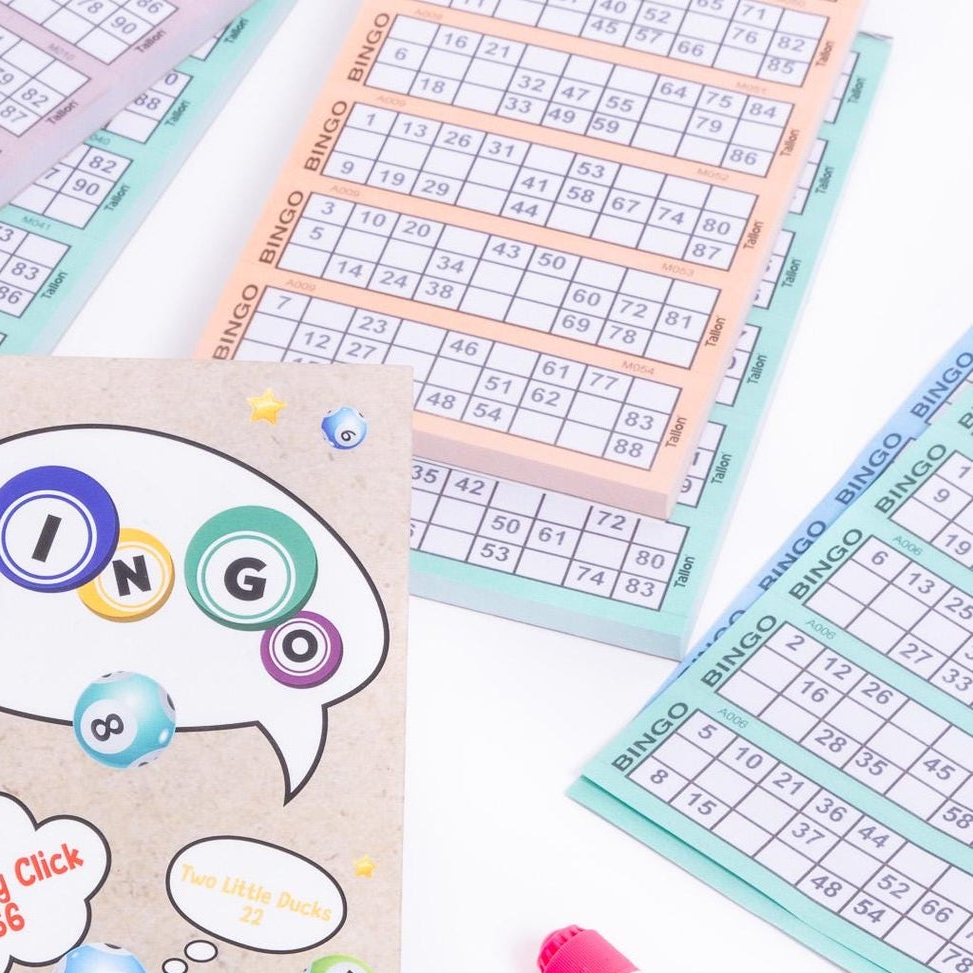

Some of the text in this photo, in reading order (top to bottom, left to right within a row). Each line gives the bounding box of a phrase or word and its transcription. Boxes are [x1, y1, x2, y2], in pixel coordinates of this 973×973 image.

[346, 12, 391, 83] BINGO
[88, 155, 117, 174] 82
[302, 100, 349, 173] BINGO
[403, 121, 606, 179] 13 26 31 53
[779, 129, 799, 156] Tallon
[71, 178, 101, 196] 90
[103, 184, 131, 212] Tallon
[339, 160, 723, 260] 9 19 29 44 87
[520, 176, 731, 236] 41 58 67 74 80
[257, 190, 305, 266] BINGO
[742, 221, 764, 249] Tallon
[10, 261, 40, 281] 83
[39, 270, 69, 299] Tallon
[276, 294, 620, 391] 7 23 46 61 77
[703, 317, 727, 347] Tallon
[304, 330, 655, 431] 12 27 51 62 83
[425, 391, 644, 458] 48 54 88
[664, 416, 688, 448] Tallon
[835, 432, 904, 506] BINGO
[873, 443, 948, 514] BINGO
[453, 476, 627, 532] 42 72
[479, 542, 656, 598] 53 74 83
[490, 514, 666, 570] 50 61 80
[787, 528, 864, 601] BINGO
[673, 556, 696, 588] Tallon
[907, 572, 936, 595] 13
[699, 614, 778, 689] BINGO
[784, 633, 895, 705] 2 12 26
[898, 642, 934, 664] 27
[90, 712, 125, 742] 8
[610, 701, 690, 773] BINGO
[800, 680, 957, 781] 16 45
[813, 728, 889, 776] 28 35
[696, 723, 891, 849] 5 10 21 36 44
[15, 843, 83, 886] Click
[649, 768, 887, 924] 8 15 48 54
[791, 821, 955, 924] 37 52 66
[181, 862, 332, 922] Two Little Ducks
[238, 906, 263, 926] 22
